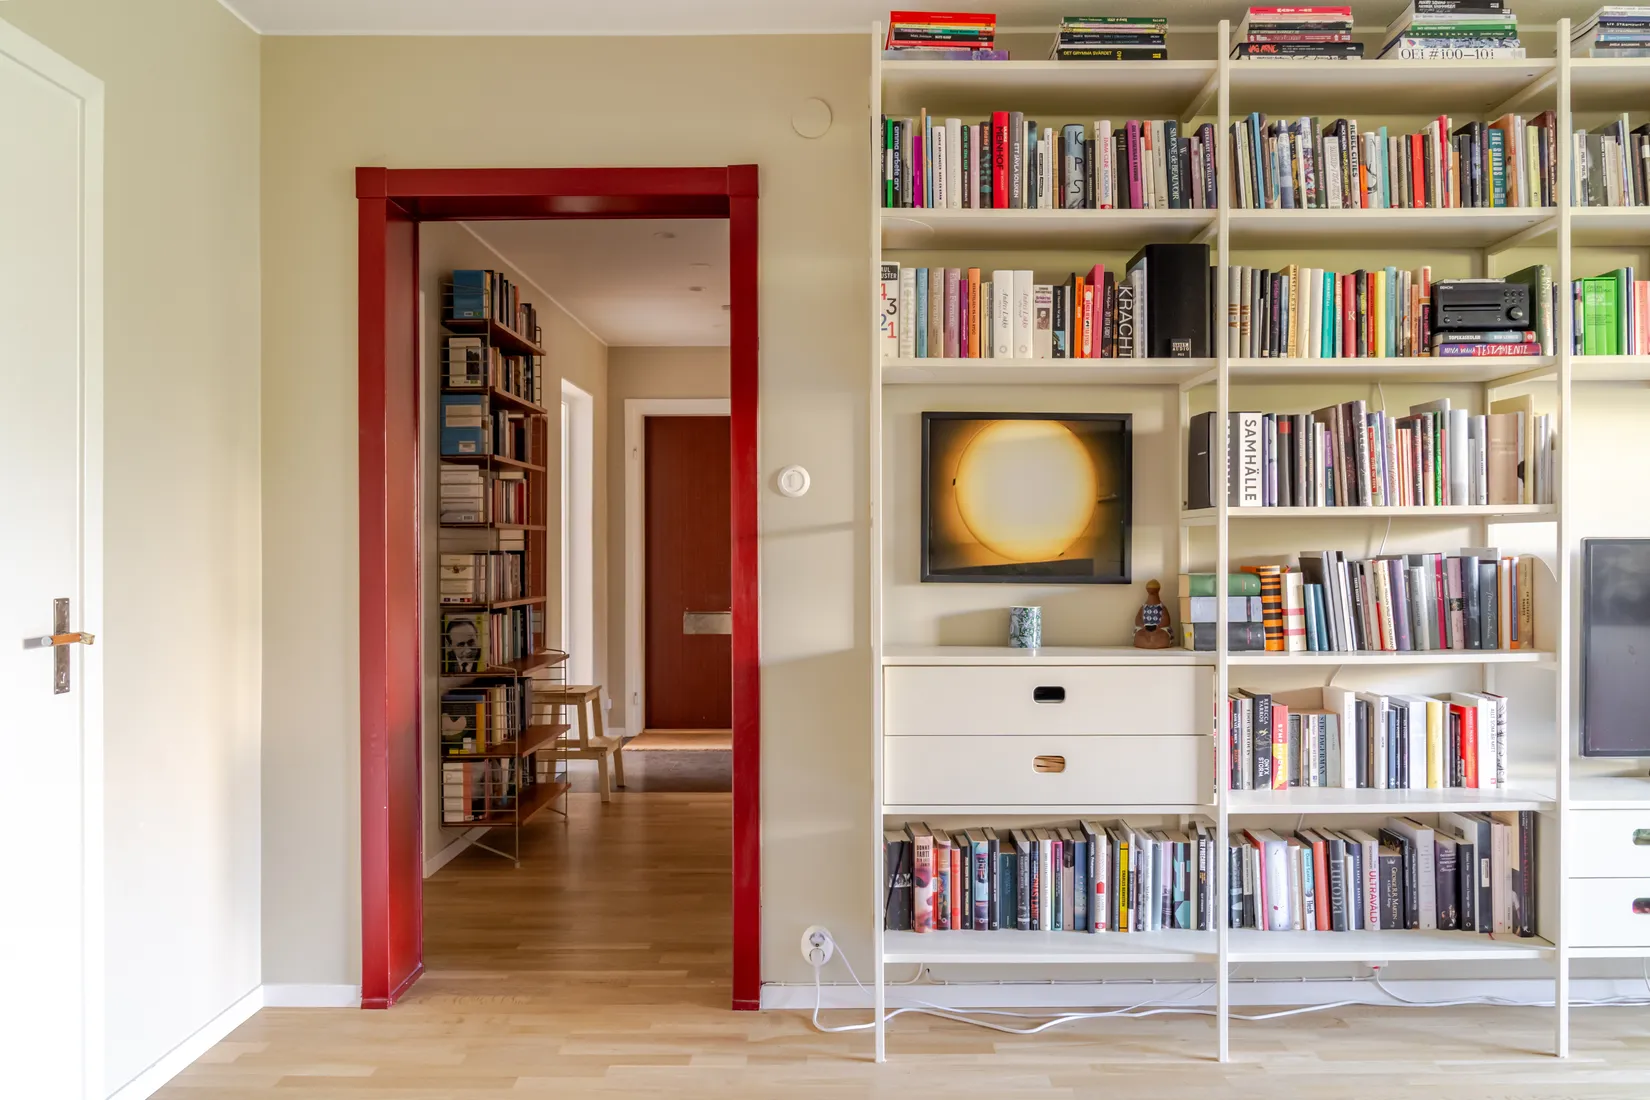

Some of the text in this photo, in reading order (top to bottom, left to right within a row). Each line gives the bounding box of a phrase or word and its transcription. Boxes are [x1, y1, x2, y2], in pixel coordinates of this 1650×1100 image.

[996, 126, 1004, 170] MEINHOF
[1074, 131, 1084, 146] K
[1206, 154, 1211, 162] OM
[1492, 133, 1503, 176] THE SHARDS
[894, 126, 902, 191] amma arbete arv
[1170, 155, 1178, 164] de
[1172, 164, 1180, 200] BEAUVOIR
[886, 298, 898, 315] 3
[1118, 286, 1133, 358] KRACHT
[887, 321, 898, 338] 1
[1475, 344, 1529, 356] TESTAMENTE
[1244, 420, 1260, 501] SAMHÄLLE
[1331, 860, 1344, 914] Europa
[1368, 870, 1378, 923] ULTRAVÅLD
